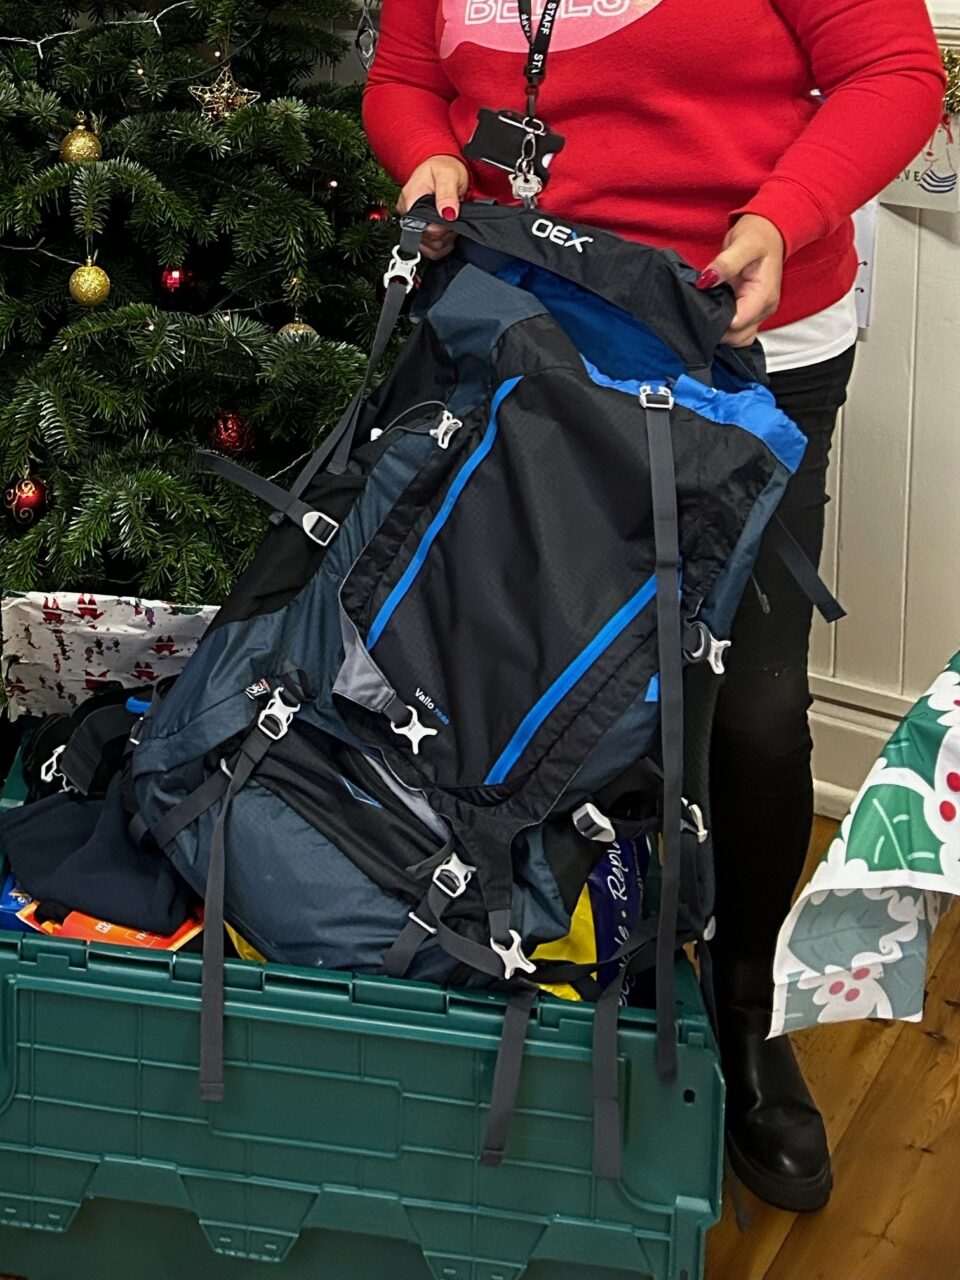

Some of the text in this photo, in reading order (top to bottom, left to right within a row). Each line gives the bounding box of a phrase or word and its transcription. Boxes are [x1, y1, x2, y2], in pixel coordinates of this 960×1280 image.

[541, 2, 557, 35] STAFF
[532, 219, 593, 253] OEX
[415, 688, 434, 710] Vallo
